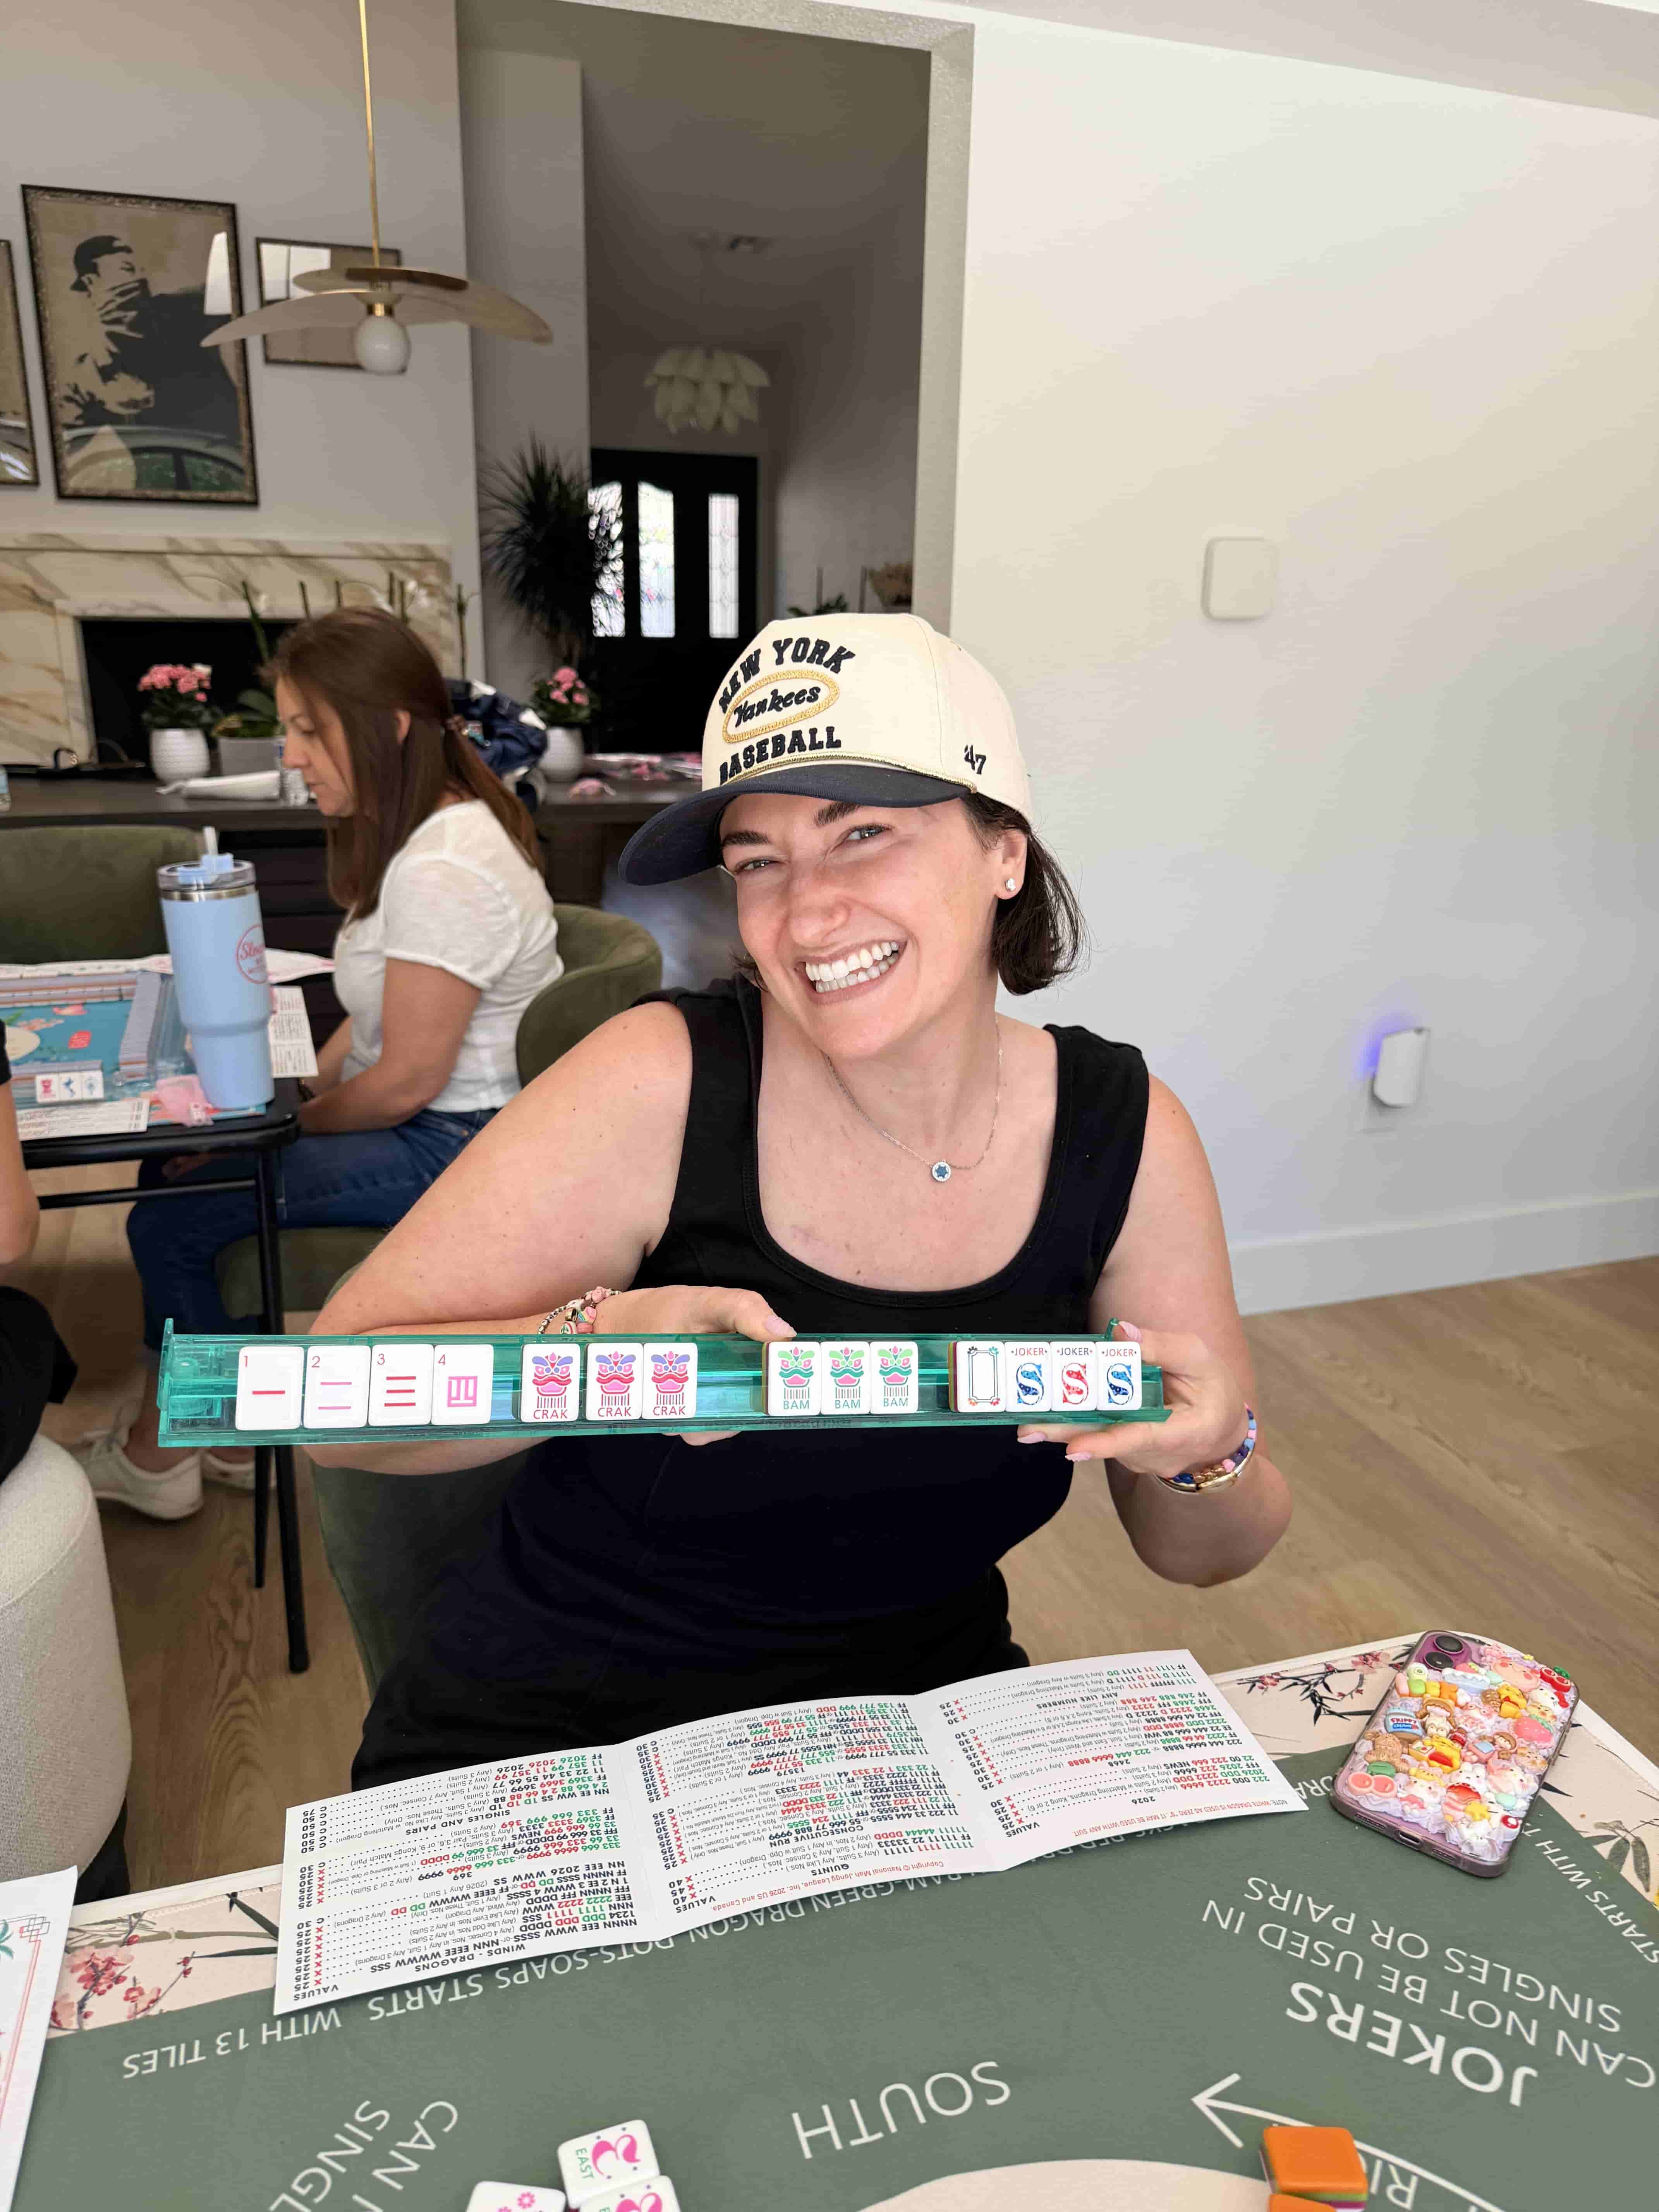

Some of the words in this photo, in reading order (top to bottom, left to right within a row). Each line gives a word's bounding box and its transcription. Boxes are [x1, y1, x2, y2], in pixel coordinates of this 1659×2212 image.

[718, 649, 761, 713] NEW
[772, 637, 855, 674] YORK
[733, 684, 821, 727] Yankees
[720, 725, 842, 785] BASEBALL
[1014, 1347, 1044, 1356] JOKER
[1060, 1347, 1089, 1356] JOKER
[1105, 1348, 1133, 1357] JOKER
[244, 1356, 248, 1367] 1
[312, 1357, 320, 1368] 2
[377, 1353, 385, 1365] 3
[438, 1354, 447, 1366] 4
[783, 1400, 809, 1409] BAM
[835, 1399, 860, 1409] BAM
[883, 1398, 908, 1407] BAM
[533, 1409, 568, 1419] CRAK
[598, 1407, 631, 1417] CRAK
[653, 1405, 686, 1415] CRAK
[1036, 1698, 1077, 1709] NUMBERS
[529, 1759, 556, 1768] 2026
[560, 1755, 587, 1764] 2026
[1108, 1759, 1130, 1767] 2468
[497, 1764, 524, 1774] 2026
[1163, 1761, 1191, 1769] NEWS
[477, 1769, 492, 1778] (Any
[777, 1767, 805, 1777] 13579
[448, 1774, 468, 1784] Suits)
[990, 1799, 1003, 1808] 30
[1131, 1796, 1156, 1805] 2026
[468, 1810, 510, 1822] SINGLES
[441, 1819, 463, 1828] AND
[406, 1824, 436, 1835] PAIRS
[793, 1825, 864, 1842] CONSECUTIVE
[1006, 1822, 1040, 1837] VALUES
[769, 1838, 790, 1848] RUN
[584, 1863, 603, 1871] EEE
[811, 1863, 849, 1876] QUINTS
[911, 1861, 944, 1869] Copyright
[1535, 1840, 1592, 1889] WITH
[551, 1865, 580, 1876] 2026
[872, 1866, 902, 1875] National
[453, 1872, 472, 1881] 369
[493, 1877, 507, 1886] SS
[512, 1871, 546, 1882] WWW
[466, 1880, 487, 1890] (2026
[802, 1877, 830, 1887] League,
[423, 1891, 441, 1899] Suit)
[561, 1891, 577, 1899] FFF
[579, 1887, 612, 1897] NNNN
[769, 1887, 786, 1896] 2026
[506, 1898, 520, 1908] (Any
[526, 1894, 558, 1905] DDDD
[557, 1898, 584, 1908] 2222
[586, 1895, 614, 1905] 2222
[675, 1896, 716, 1913] VALUES
[742, 1896, 755, 1904] and
[1244, 1877, 1355, 1932] PAIRS
[522, 1903, 555, 1914] WWW
[711, 1899, 740, 1911] Canada.
[446, 1910, 471, 1919] Dragon)
[1202, 1900, 1244, 1933] IN
[297, 1921, 312, 1930] 30
[689, 1899, 805, 1943] DRAGON
[410, 1927, 428, 1936] Suits)
[1585, 1891, 1659, 1963] STARTS
[1372, 1926, 1429, 1960] OR
[296, 1946, 311, 1956] 25
[487, 1944, 526, 1956] WINDS
[1259, 1924, 1363, 1979] USED
[295, 1955, 311, 1965] 25
[415, 1953, 474, 1972] DRAGONS
[1380, 1967, 1427, 2003] BE
[294, 1984, 339, 2001] VALUES
[1444, 1948, 1623, 2033] SINGLES
[369, 1973, 483, 2021] STARTS
[1440, 1994, 1538, 2046] NOT
[261, 2008, 342, 2046] WITH
[216, 2032, 250, 2057] 13
[1286, 1982, 1538, 2106] JOKERS
[123, 2046, 206, 2080] TILES
[1556, 2029, 1657, 2088] CAN
[791, 2060, 1012, 2159] SOUTH
[371, 2100, 459, 2191] CAN
[576, 2148, 594, 2179] EAST
